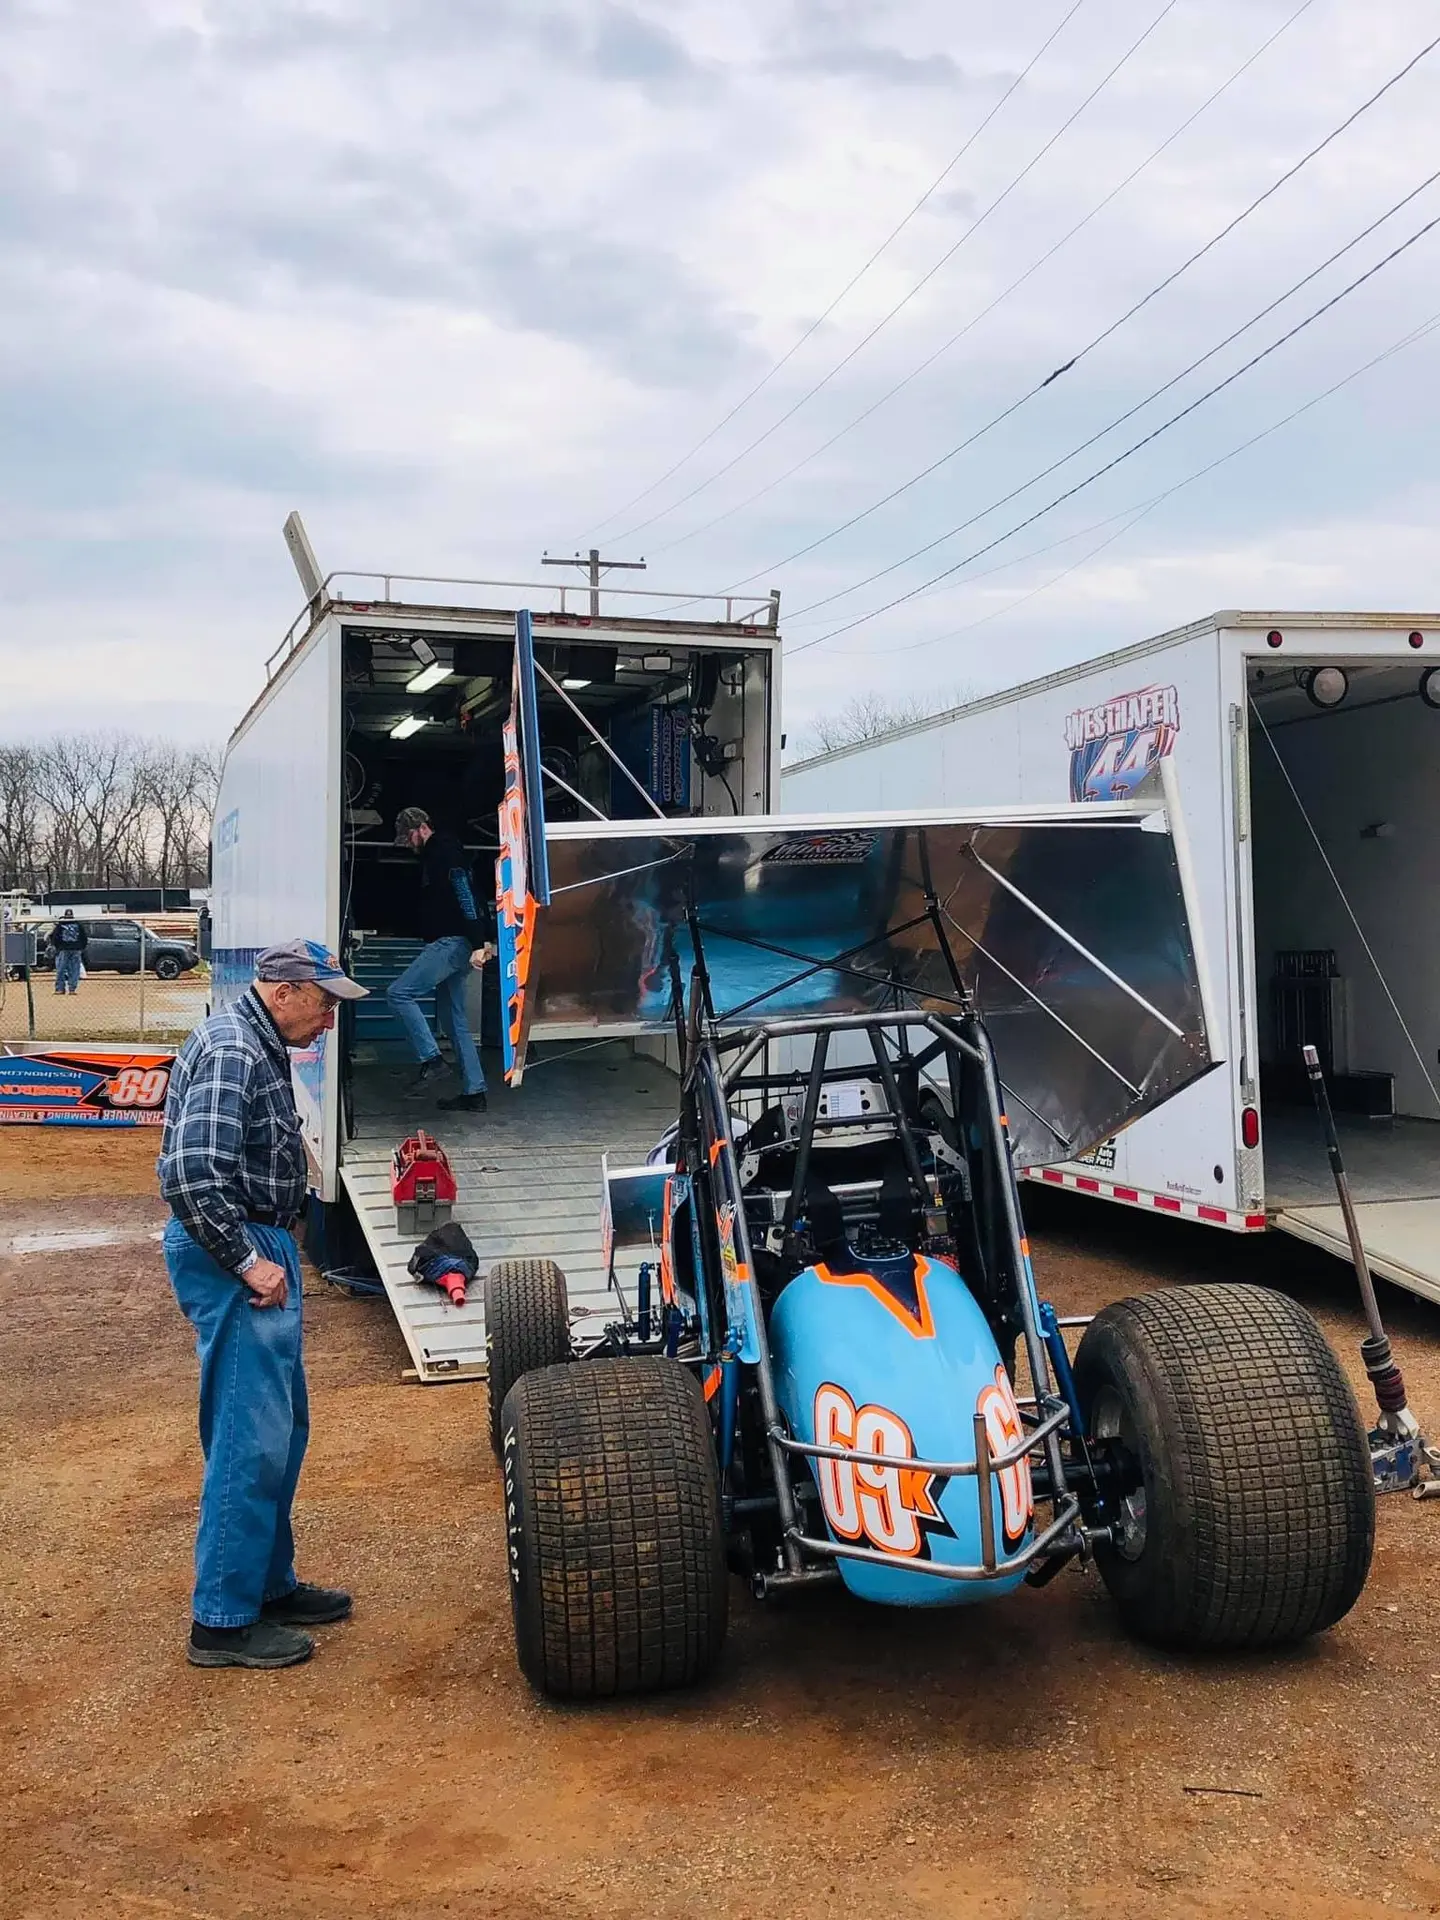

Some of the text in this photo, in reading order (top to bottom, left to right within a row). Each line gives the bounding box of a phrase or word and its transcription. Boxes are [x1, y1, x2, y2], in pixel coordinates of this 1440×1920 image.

[1064, 685, 1181, 750] WESTHAFER
[1081, 728, 1160, 801] 44
[37, 1110, 46, 1121] &
[47, 1111, 100, 1121] PLUMBING
[1098, 1147, 1113, 1158] Auto
[1095, 1156, 1113, 1167] Parts
